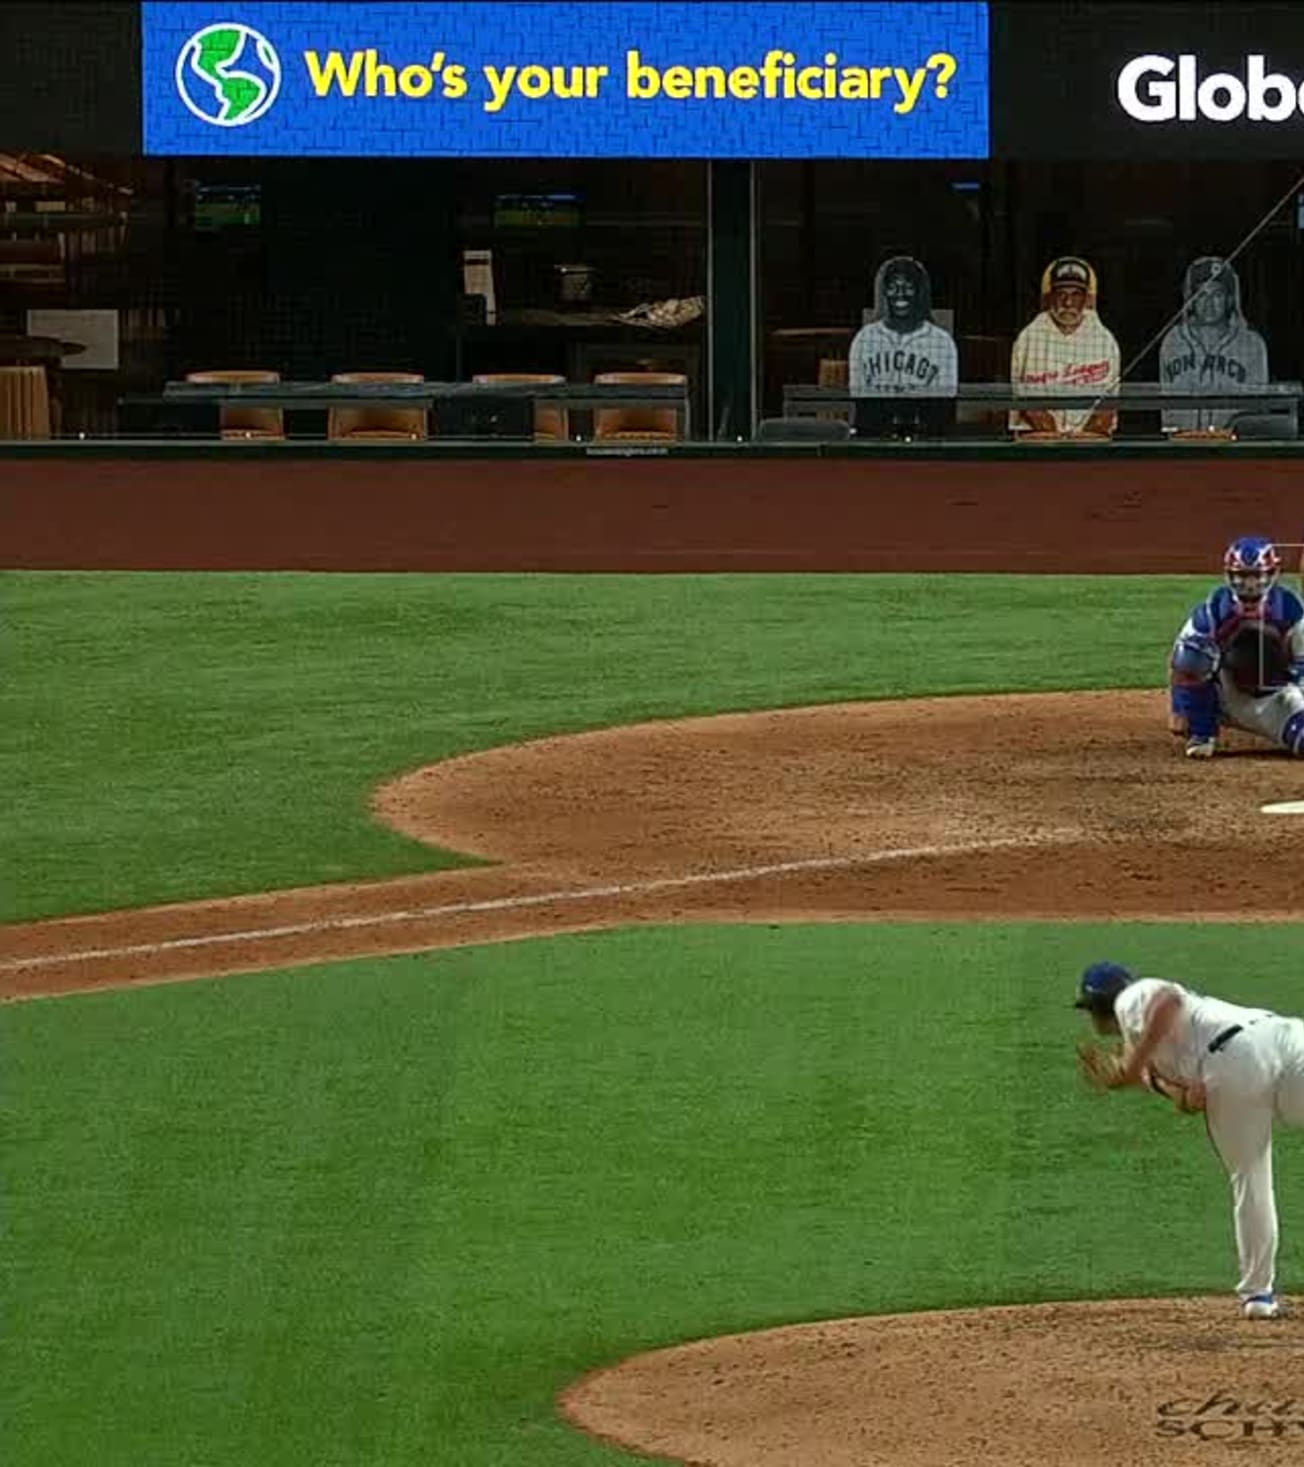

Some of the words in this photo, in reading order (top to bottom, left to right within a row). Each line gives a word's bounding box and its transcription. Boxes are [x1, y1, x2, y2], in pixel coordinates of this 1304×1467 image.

[305, 48, 468, 98] Who's
[484, 64, 609, 112] your
[627, 49, 957, 114] beneficiary?
